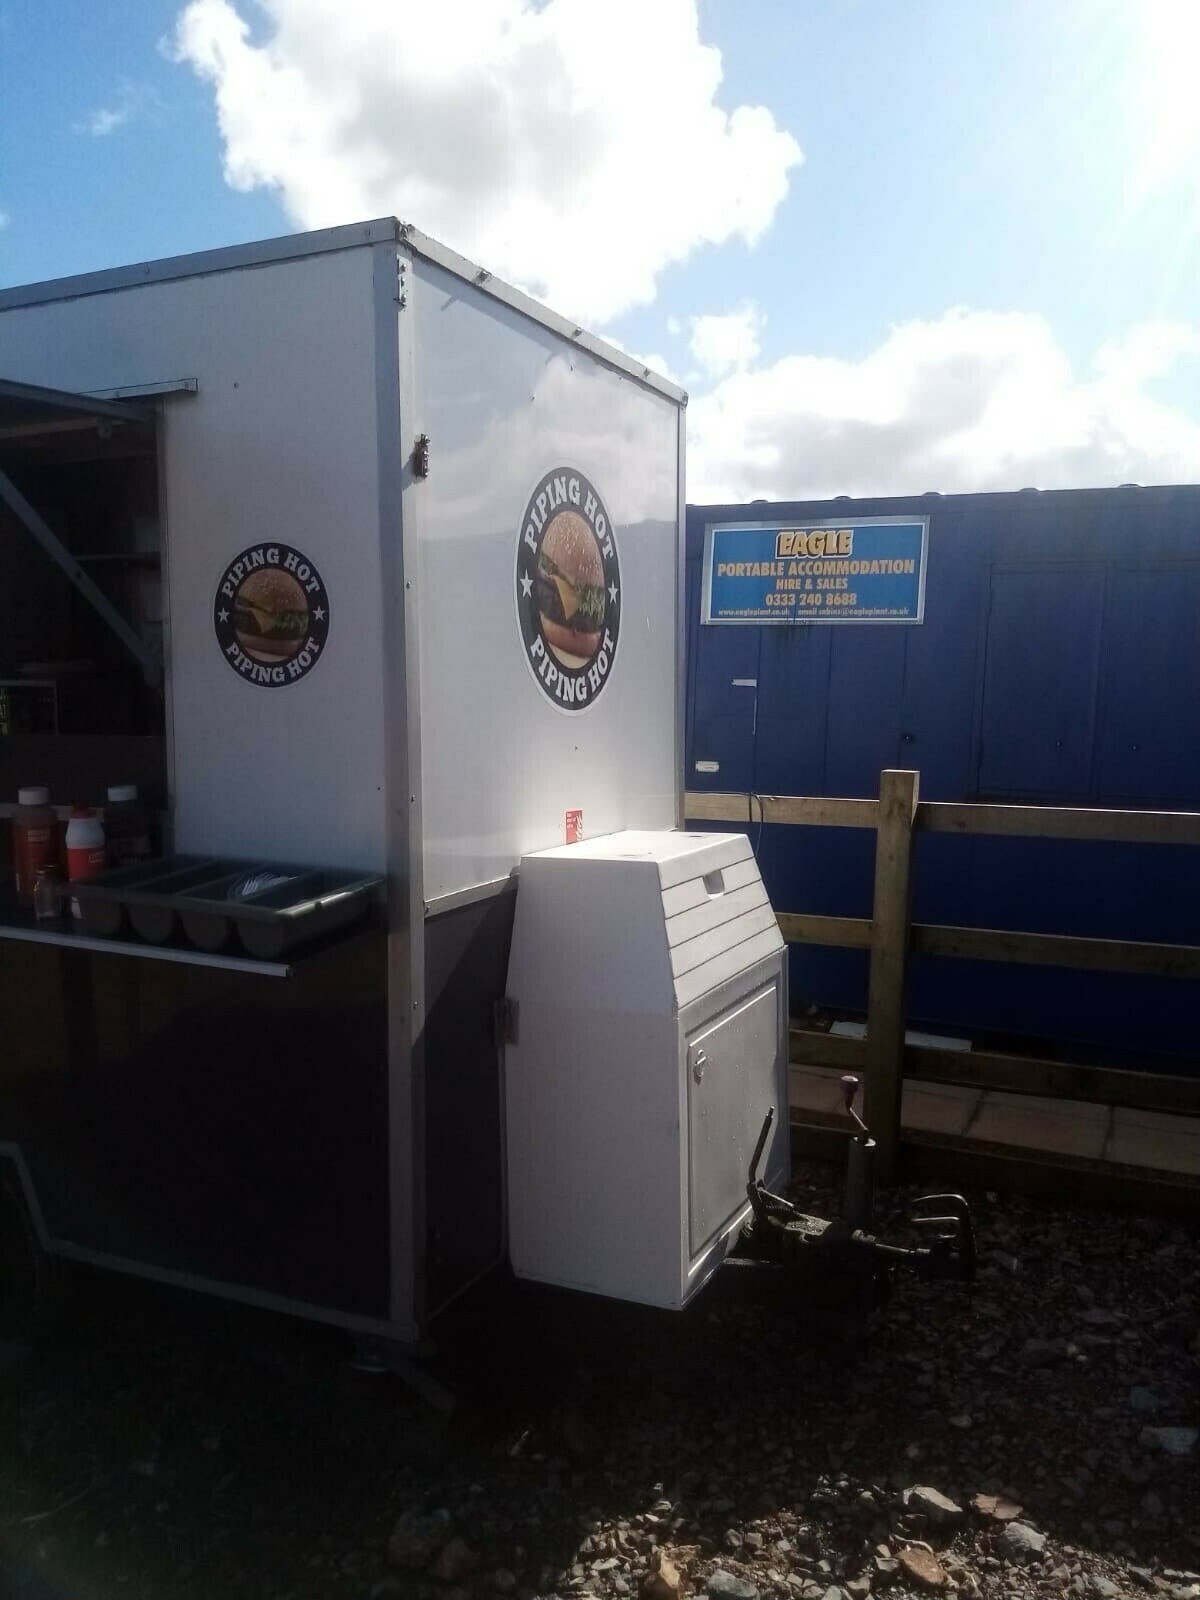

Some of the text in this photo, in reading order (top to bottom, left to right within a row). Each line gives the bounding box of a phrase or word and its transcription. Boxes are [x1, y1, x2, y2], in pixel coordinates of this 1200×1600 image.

[524, 476, 615, 559] PIPING HOT
[776, 530, 853, 559] EAGLE
[221, 548, 320, 598] PIPING HOT
[717, 559, 914, 577] PORTABLE ACCOMMODATION
[776, 578, 848, 590] HIRE & SALES
[765, 594, 796, 606] 0333
[799, 593, 822, 606] 240
[225, 636, 320, 683] PIPING HOT
[530, 628, 615, 703] PIPING HOT
